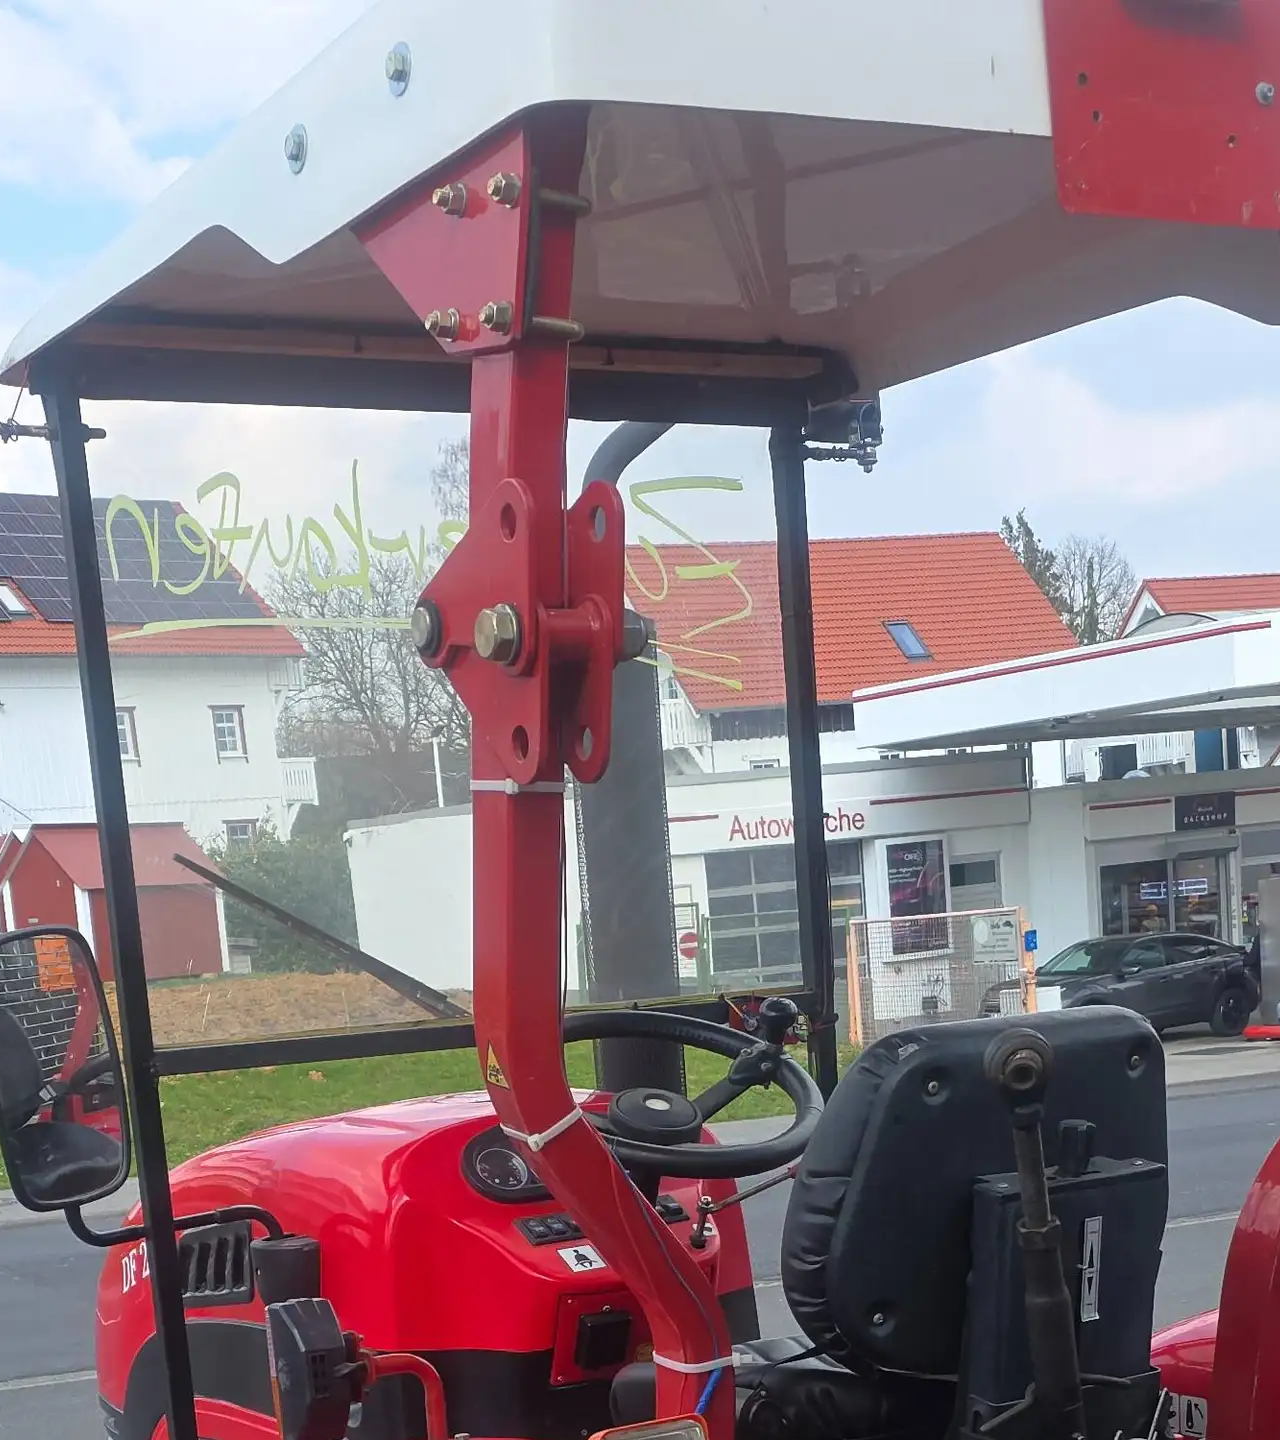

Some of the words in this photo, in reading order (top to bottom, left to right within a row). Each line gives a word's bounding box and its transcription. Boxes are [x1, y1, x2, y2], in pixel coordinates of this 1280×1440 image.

[729, 807, 865, 841] Autowche
[121, 1248, 137, 1293] DF
[139, 1241, 150, 1278] 2
